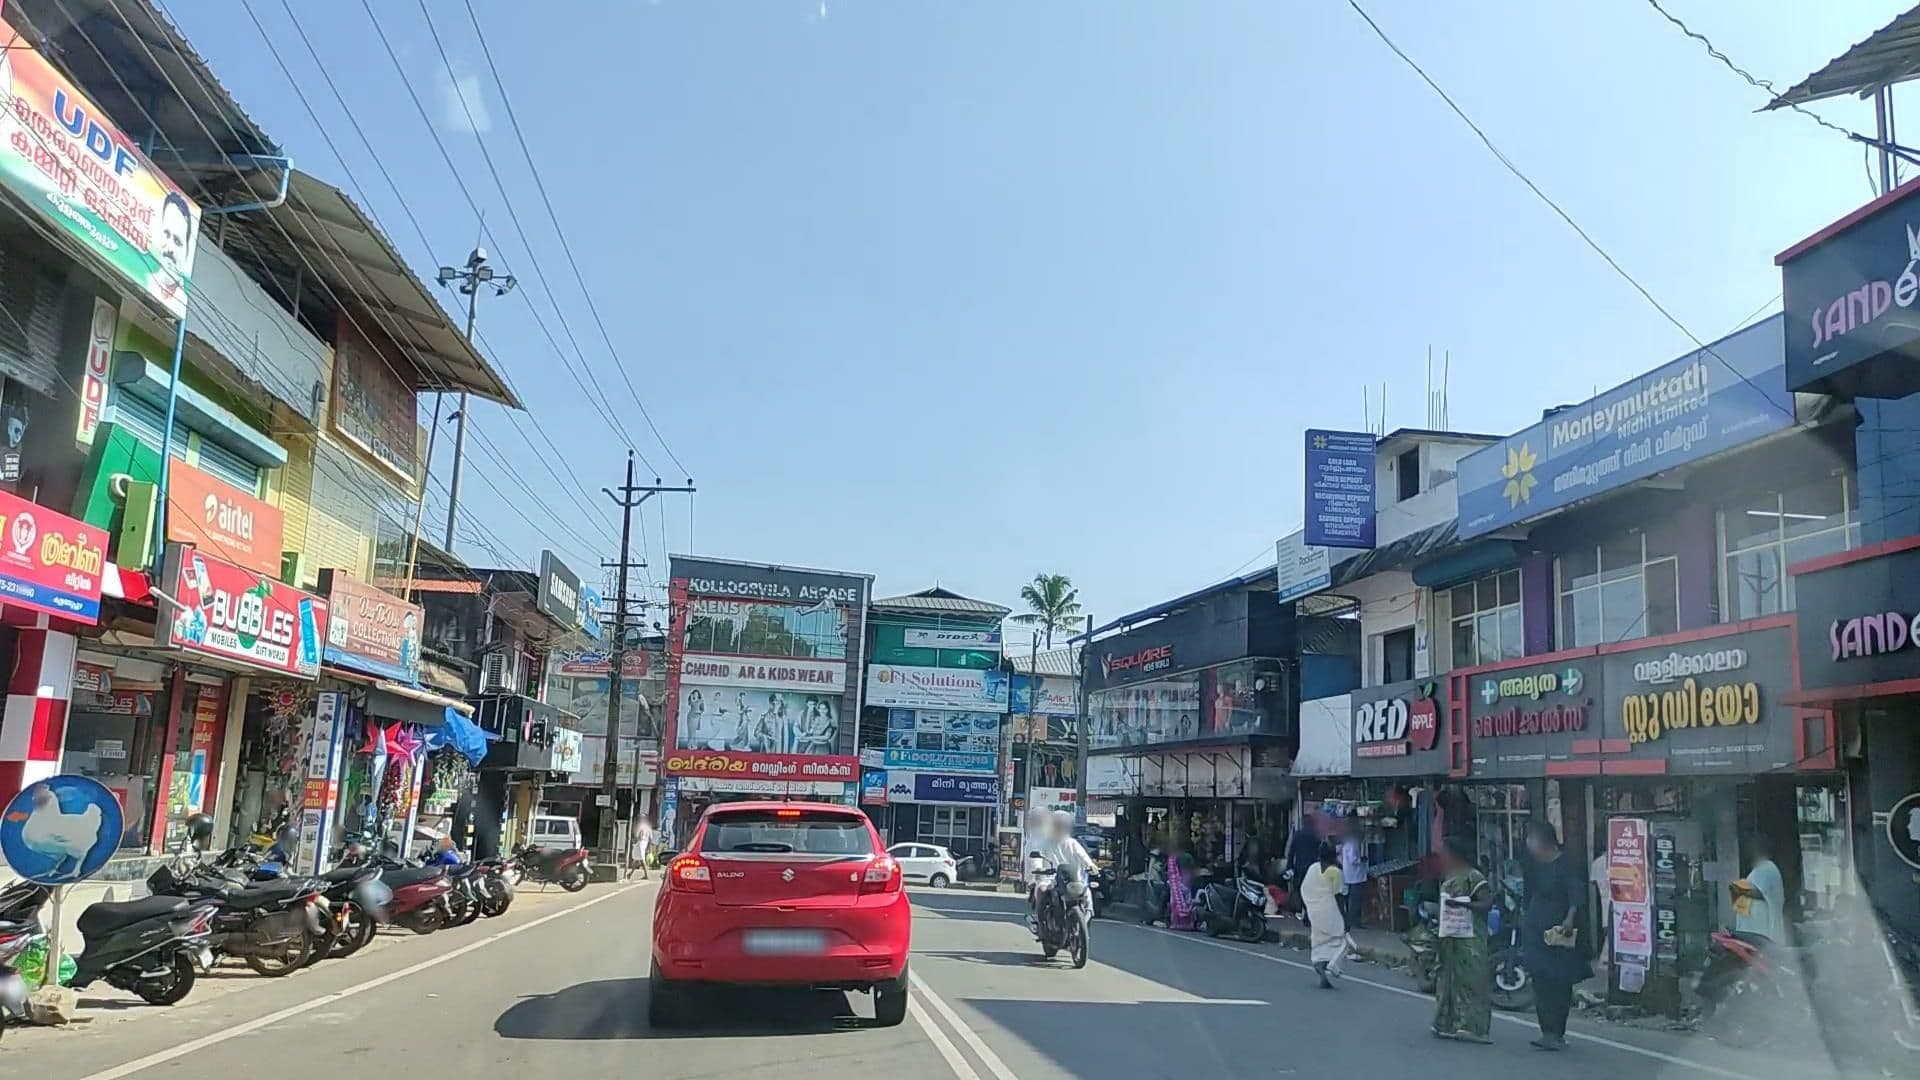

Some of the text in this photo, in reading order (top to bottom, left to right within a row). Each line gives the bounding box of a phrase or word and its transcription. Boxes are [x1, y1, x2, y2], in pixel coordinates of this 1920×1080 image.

[54, 86, 138, 177] UDF
[83, 344, 108, 433] UDF
[1552, 361, 1708, 449] Moneymuttath
[1618, 410, 1651, 440] Nidhi
[1655, 388, 1708, 425] Limited
[219, 500, 254, 541] airtel
[550, 572, 577, 611] SAMSUNG
[799, 587, 857, 602] ARCADE
[211, 588, 295, 647] BUBBLES
[211, 631, 286, 662] MOBILES GIFT WORLD
[353, 622, 401, 650] COLLECTIONS
[936, 633, 970, 641] DTDC
[685, 663, 834, 684] CHURID AR & KIDS WEAR
[1111, 645, 1173, 671] SQUARE
[911, 671, 982, 689] Solutions
[1500, 674, 1558, 700] അമൃത
[1356, 698, 1434, 743] RED APPLE
[1623, 677, 1760, 744] സ്റ്റുഡിയോ
[931, 777, 955, 789] മിനി
